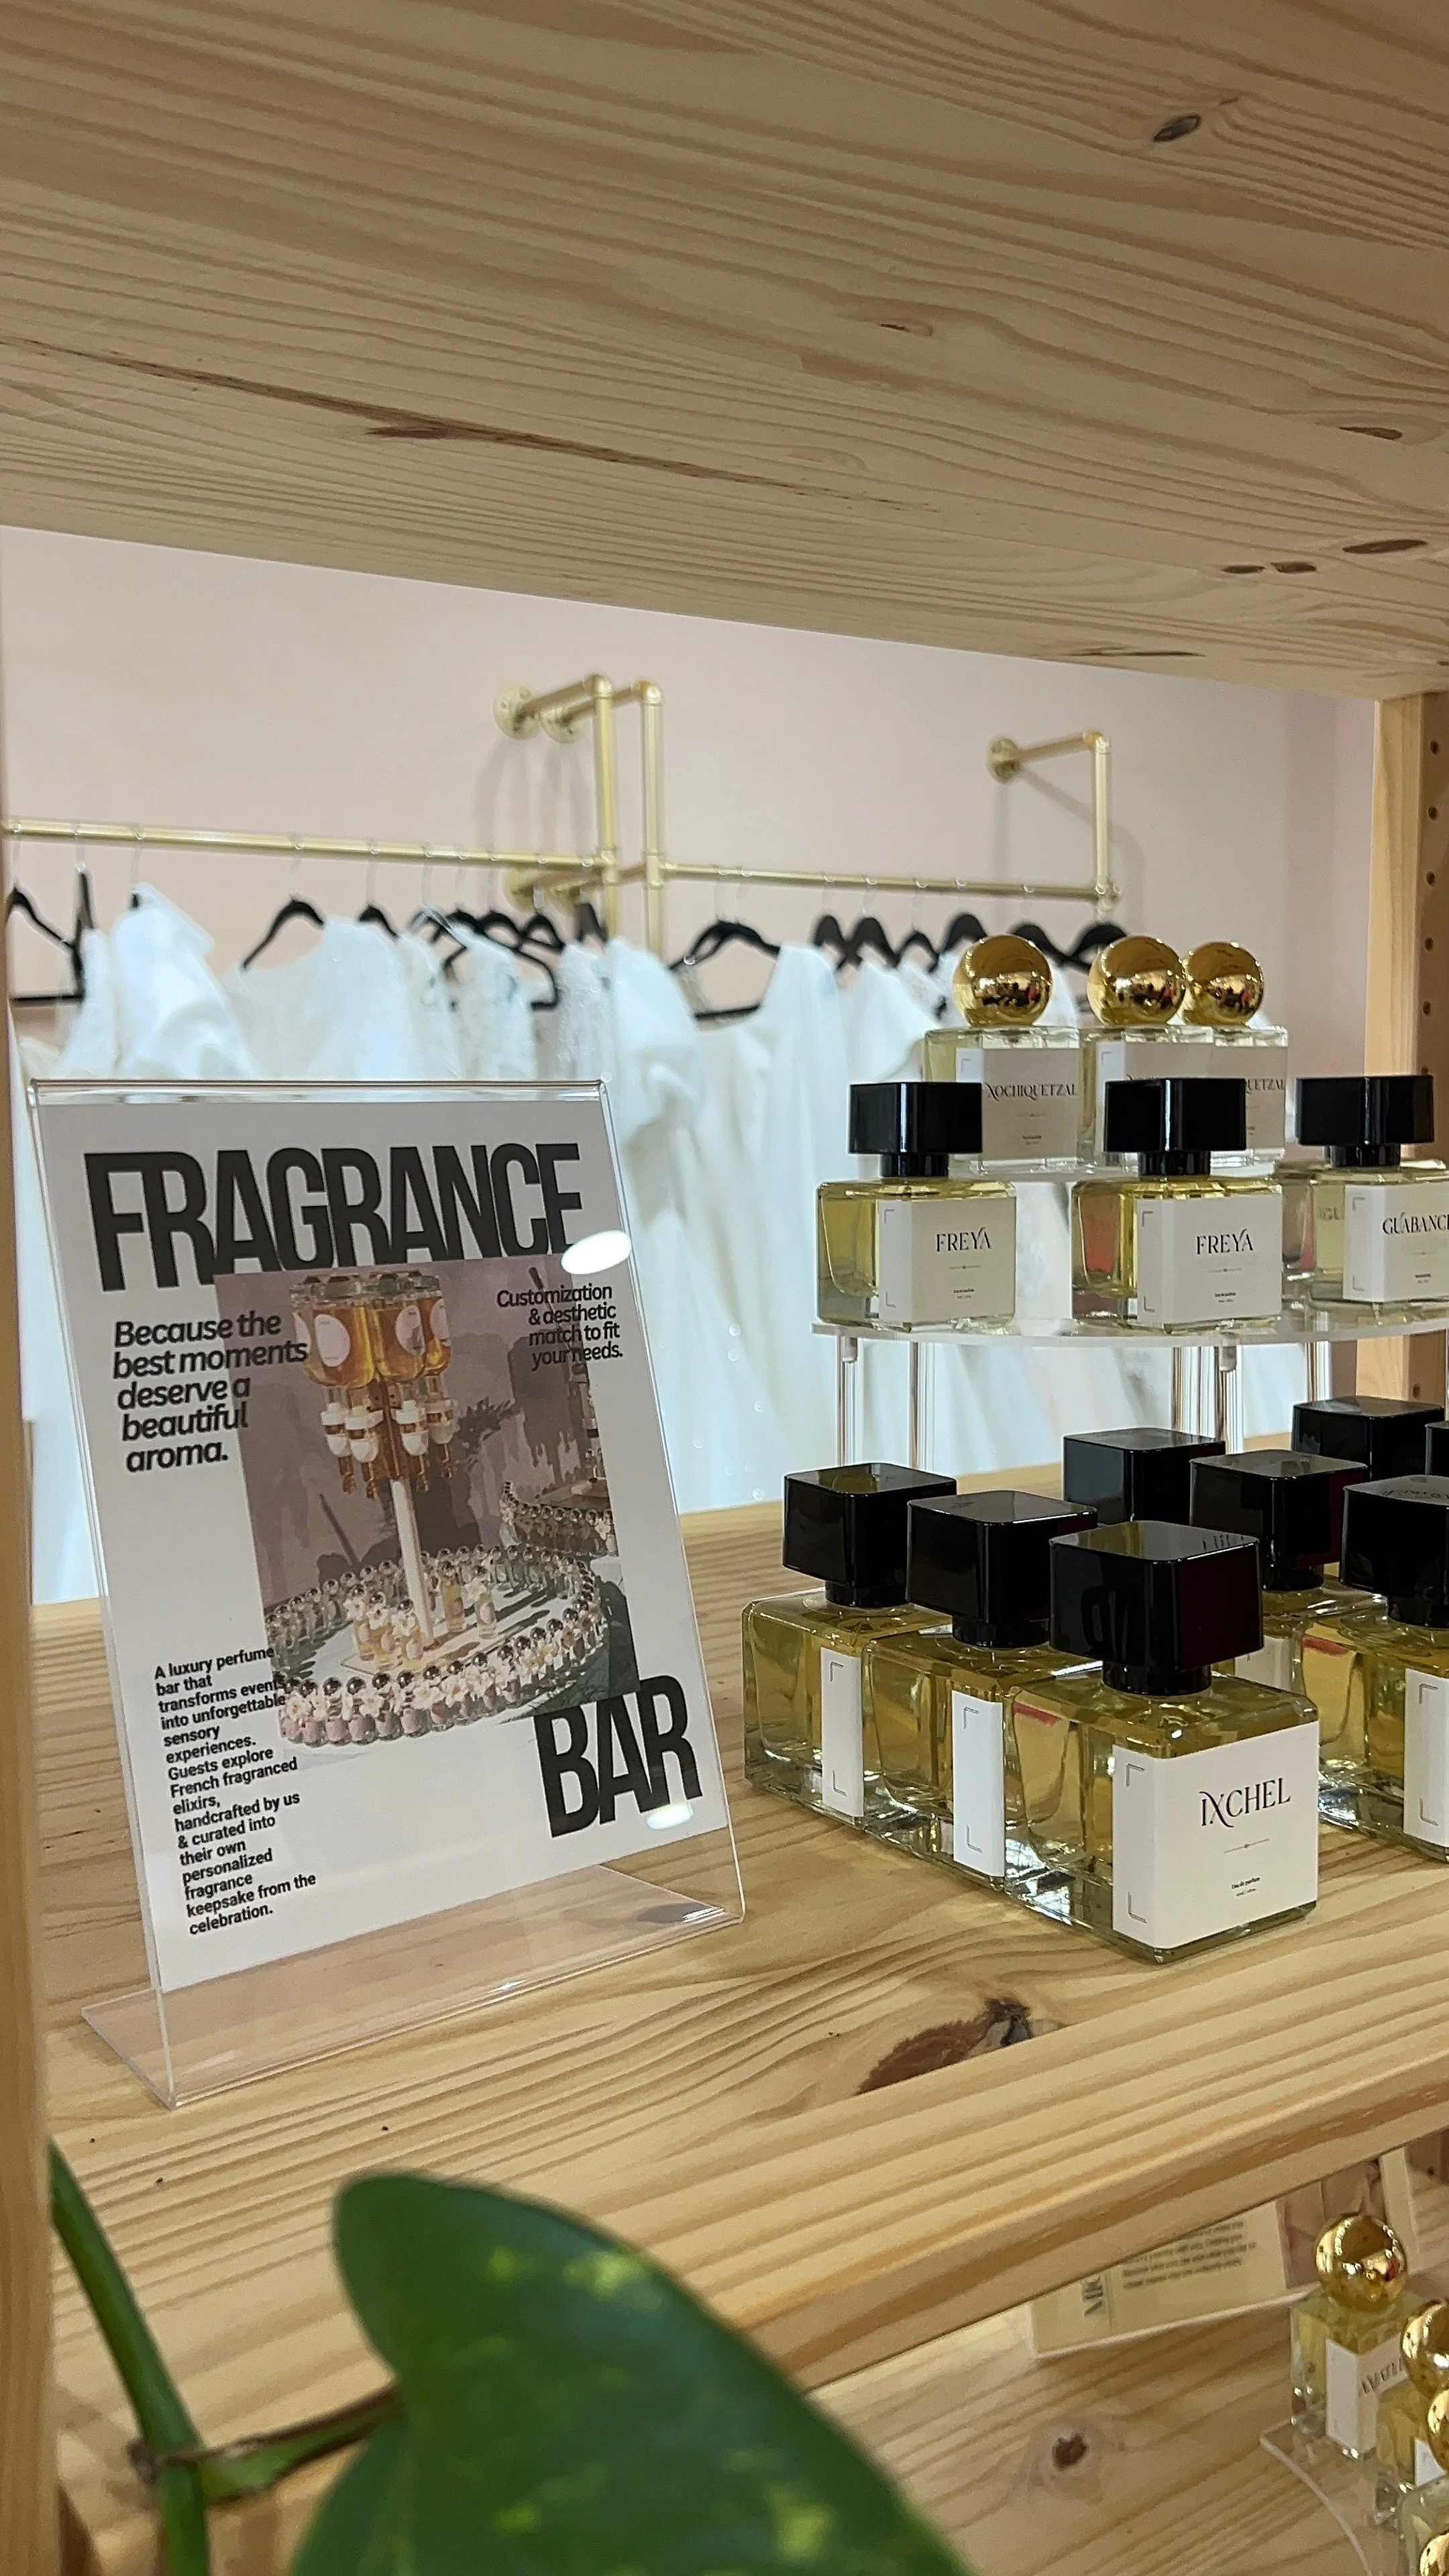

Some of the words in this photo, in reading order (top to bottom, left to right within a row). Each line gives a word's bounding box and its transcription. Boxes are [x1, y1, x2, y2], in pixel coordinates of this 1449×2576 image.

[85, 1143, 582, 1291] FRAGRANCE
[936, 1227, 991, 1252] FREYA
[1197, 1228, 1253, 1254] FREYA
[497, 1283, 612, 1307] Customization
[115, 1319, 234, 1348] Because
[237, 1310, 281, 1338] the
[528, 1308, 541, 1326] &
[543, 1301, 616, 1325] aesthetic
[529, 1324, 582, 1346] match
[584, 1325, 600, 1341] to
[603, 1320, 621, 1339] fit
[113, 1351, 176, 1380] best
[179, 1340, 308, 1373] moments
[532, 1349, 570, 1371] your
[572, 1340, 623, 1362] needs.
[117, 1381, 228, 1409] deserve
[233, 1377, 250, 1398] a
[122, 1401, 248, 1441] beautiful
[126, 1442, 229, 1473] aroma.
[154, 1666, 166, 1679] A
[168, 1659, 213, 1676] luxury
[217, 1648, 274, 1670] perfume
[156, 1682, 180, 1696] bar
[184, 1675, 213, 1690] that
[158, 1688, 237, 1713] transforms
[161, 1715, 189, 1730] into
[193, 1693, 286, 1723] unforgettable
[164, 1725, 219, 1747] sensory
[166, 1736, 256, 1763] experiences.
[168, 1761, 218, 1780] Guests
[222, 1749, 274, 1768] explore
[537, 1674, 702, 1838] BAR
[170, 1776, 219, 1798] French
[223, 1756, 298, 1785] fragranced
[173, 1796, 220, 1815] elixirs,
[174, 1799, 260, 1831] handcrafted
[263, 1797, 280, 1812] by
[283, 1793, 300, 1806] us
[1199, 1778, 1291, 1827] IXCHEL
[178, 1835, 189, 1849] &
[192, 1820, 246, 1845] curated
[249, 1816, 276, 1831] into
[180, 1847, 213, 1866] their
[217, 1841, 246, 1857] own
[182, 1847, 273, 1886] personalized
[184, 1874, 253, 1900] fragrance
[186, 1890, 254, 1917] keepsake
[258, 1880, 291, 1898] from
[293, 1874, 317, 1889] the
[189, 1905, 273, 1935] celebration.
